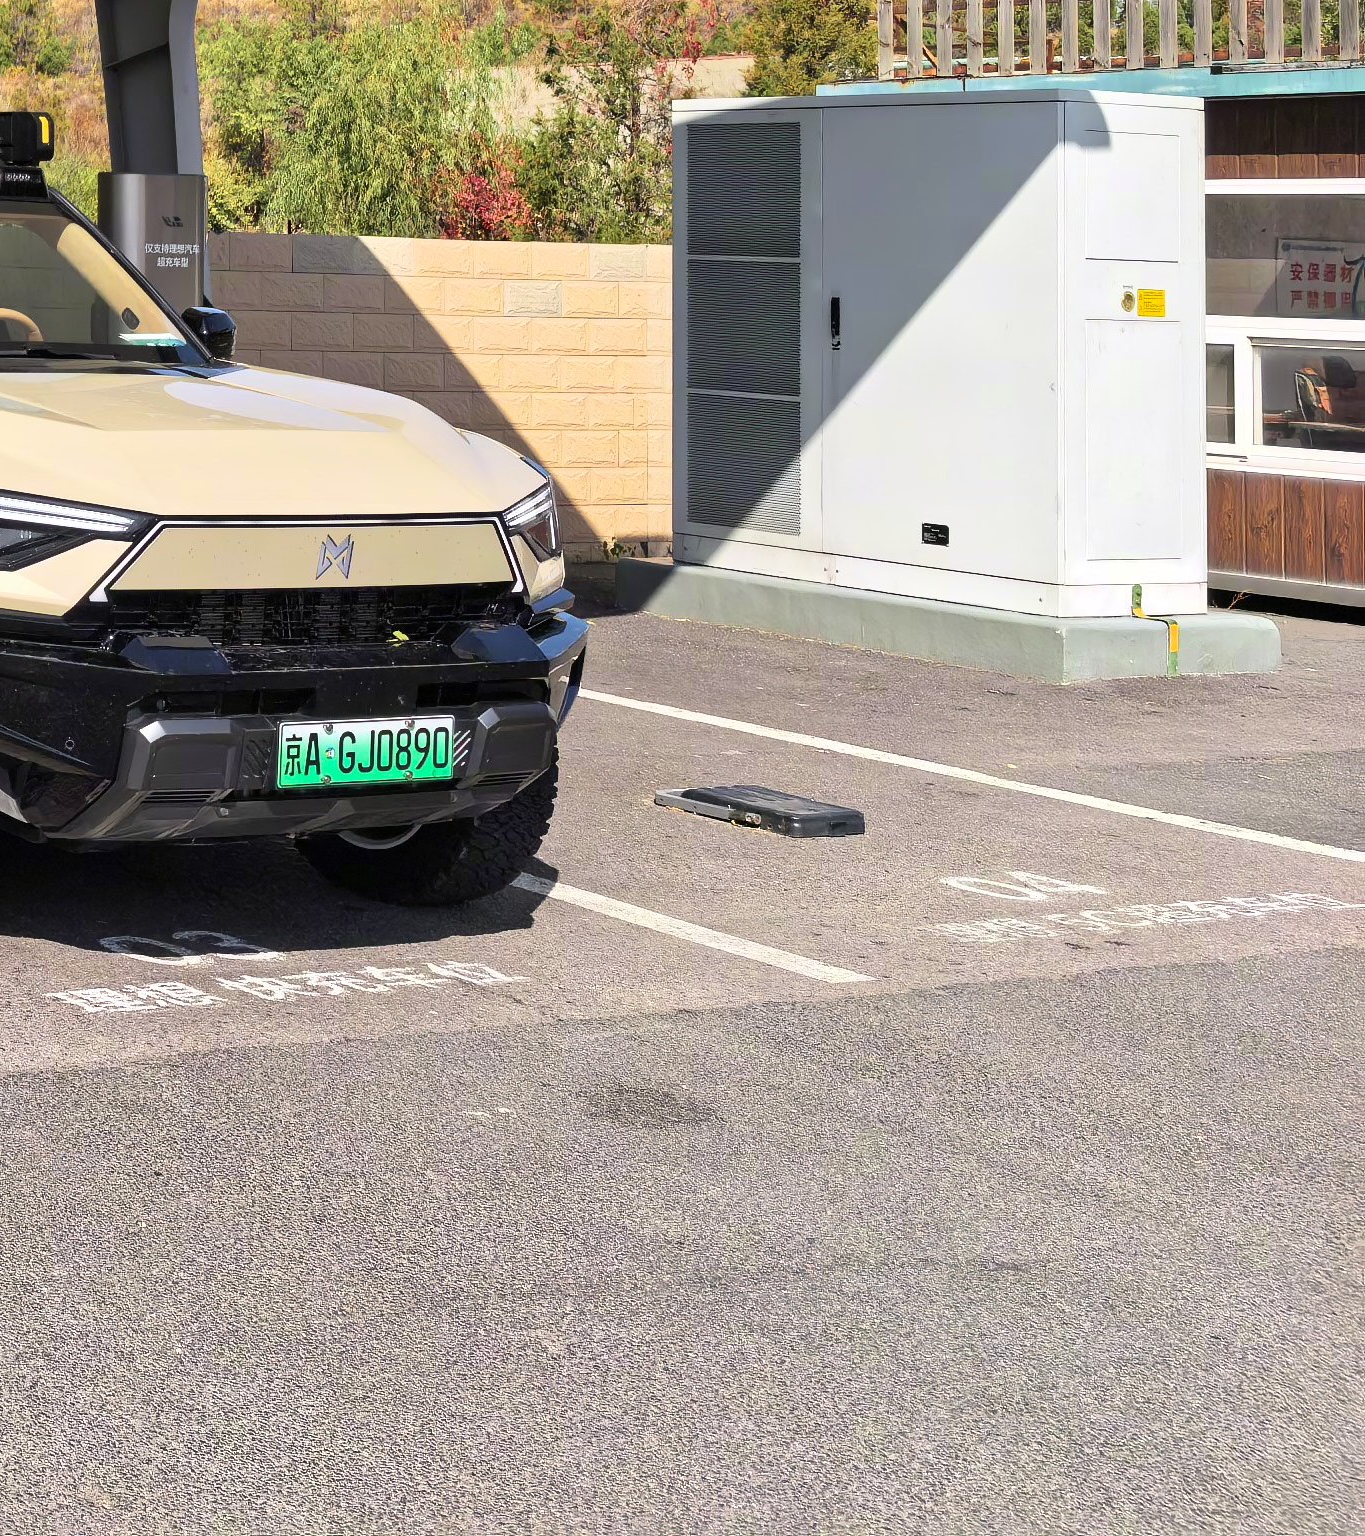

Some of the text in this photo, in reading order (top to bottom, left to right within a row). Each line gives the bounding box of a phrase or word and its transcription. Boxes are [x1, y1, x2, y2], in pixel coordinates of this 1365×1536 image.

[145, 243, 200, 255] 仅支持理想汽车
[156, 256, 189, 268] 超充车型
[939, 871, 1109, 902] 04
